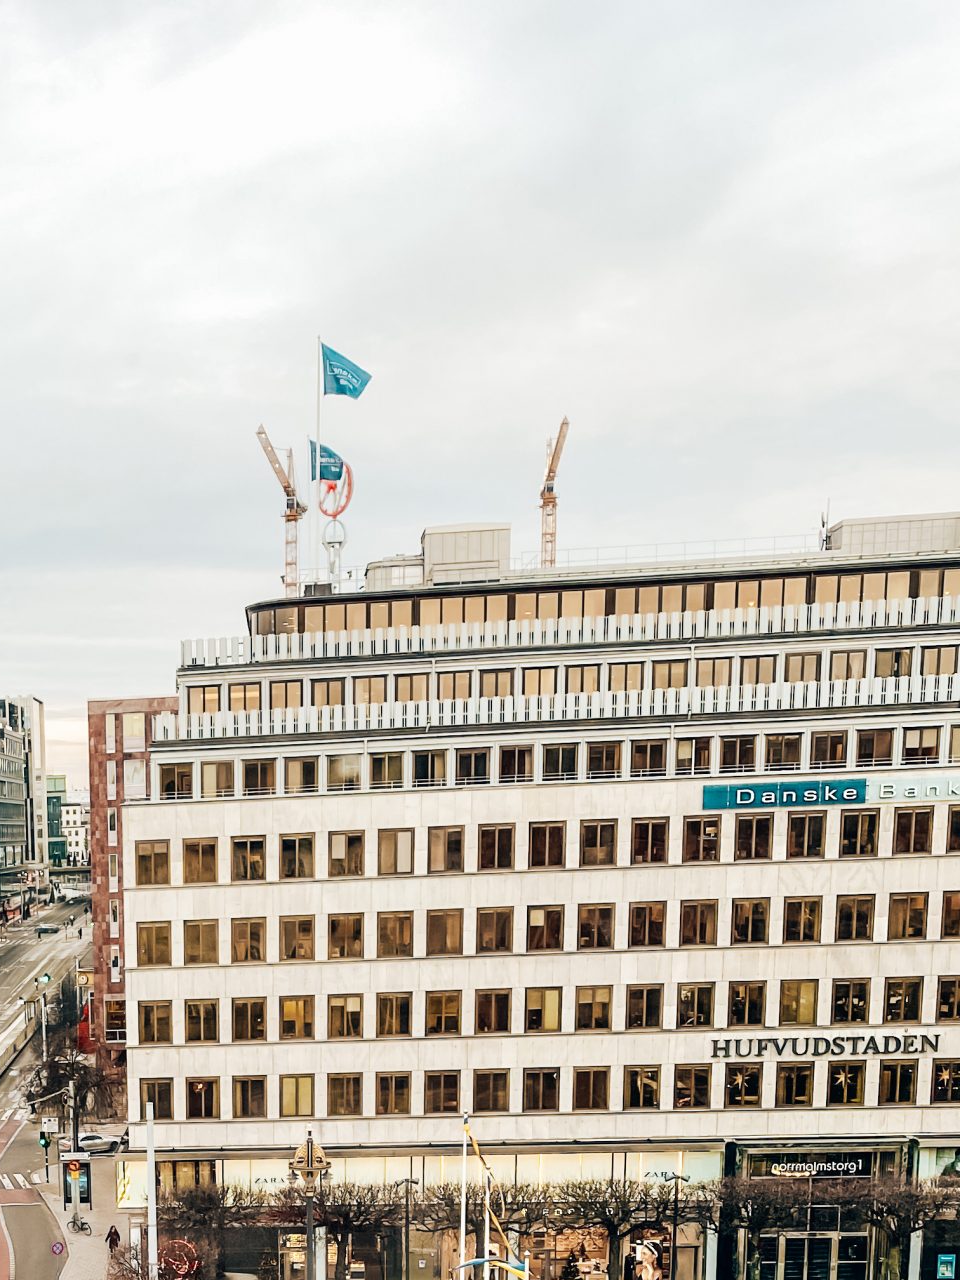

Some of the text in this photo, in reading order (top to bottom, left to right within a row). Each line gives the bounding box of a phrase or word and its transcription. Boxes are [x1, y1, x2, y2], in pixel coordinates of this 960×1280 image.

[736, 781, 960, 804] Danske Bank
[711, 1034, 941, 1058] HUFVUDSTADEN
